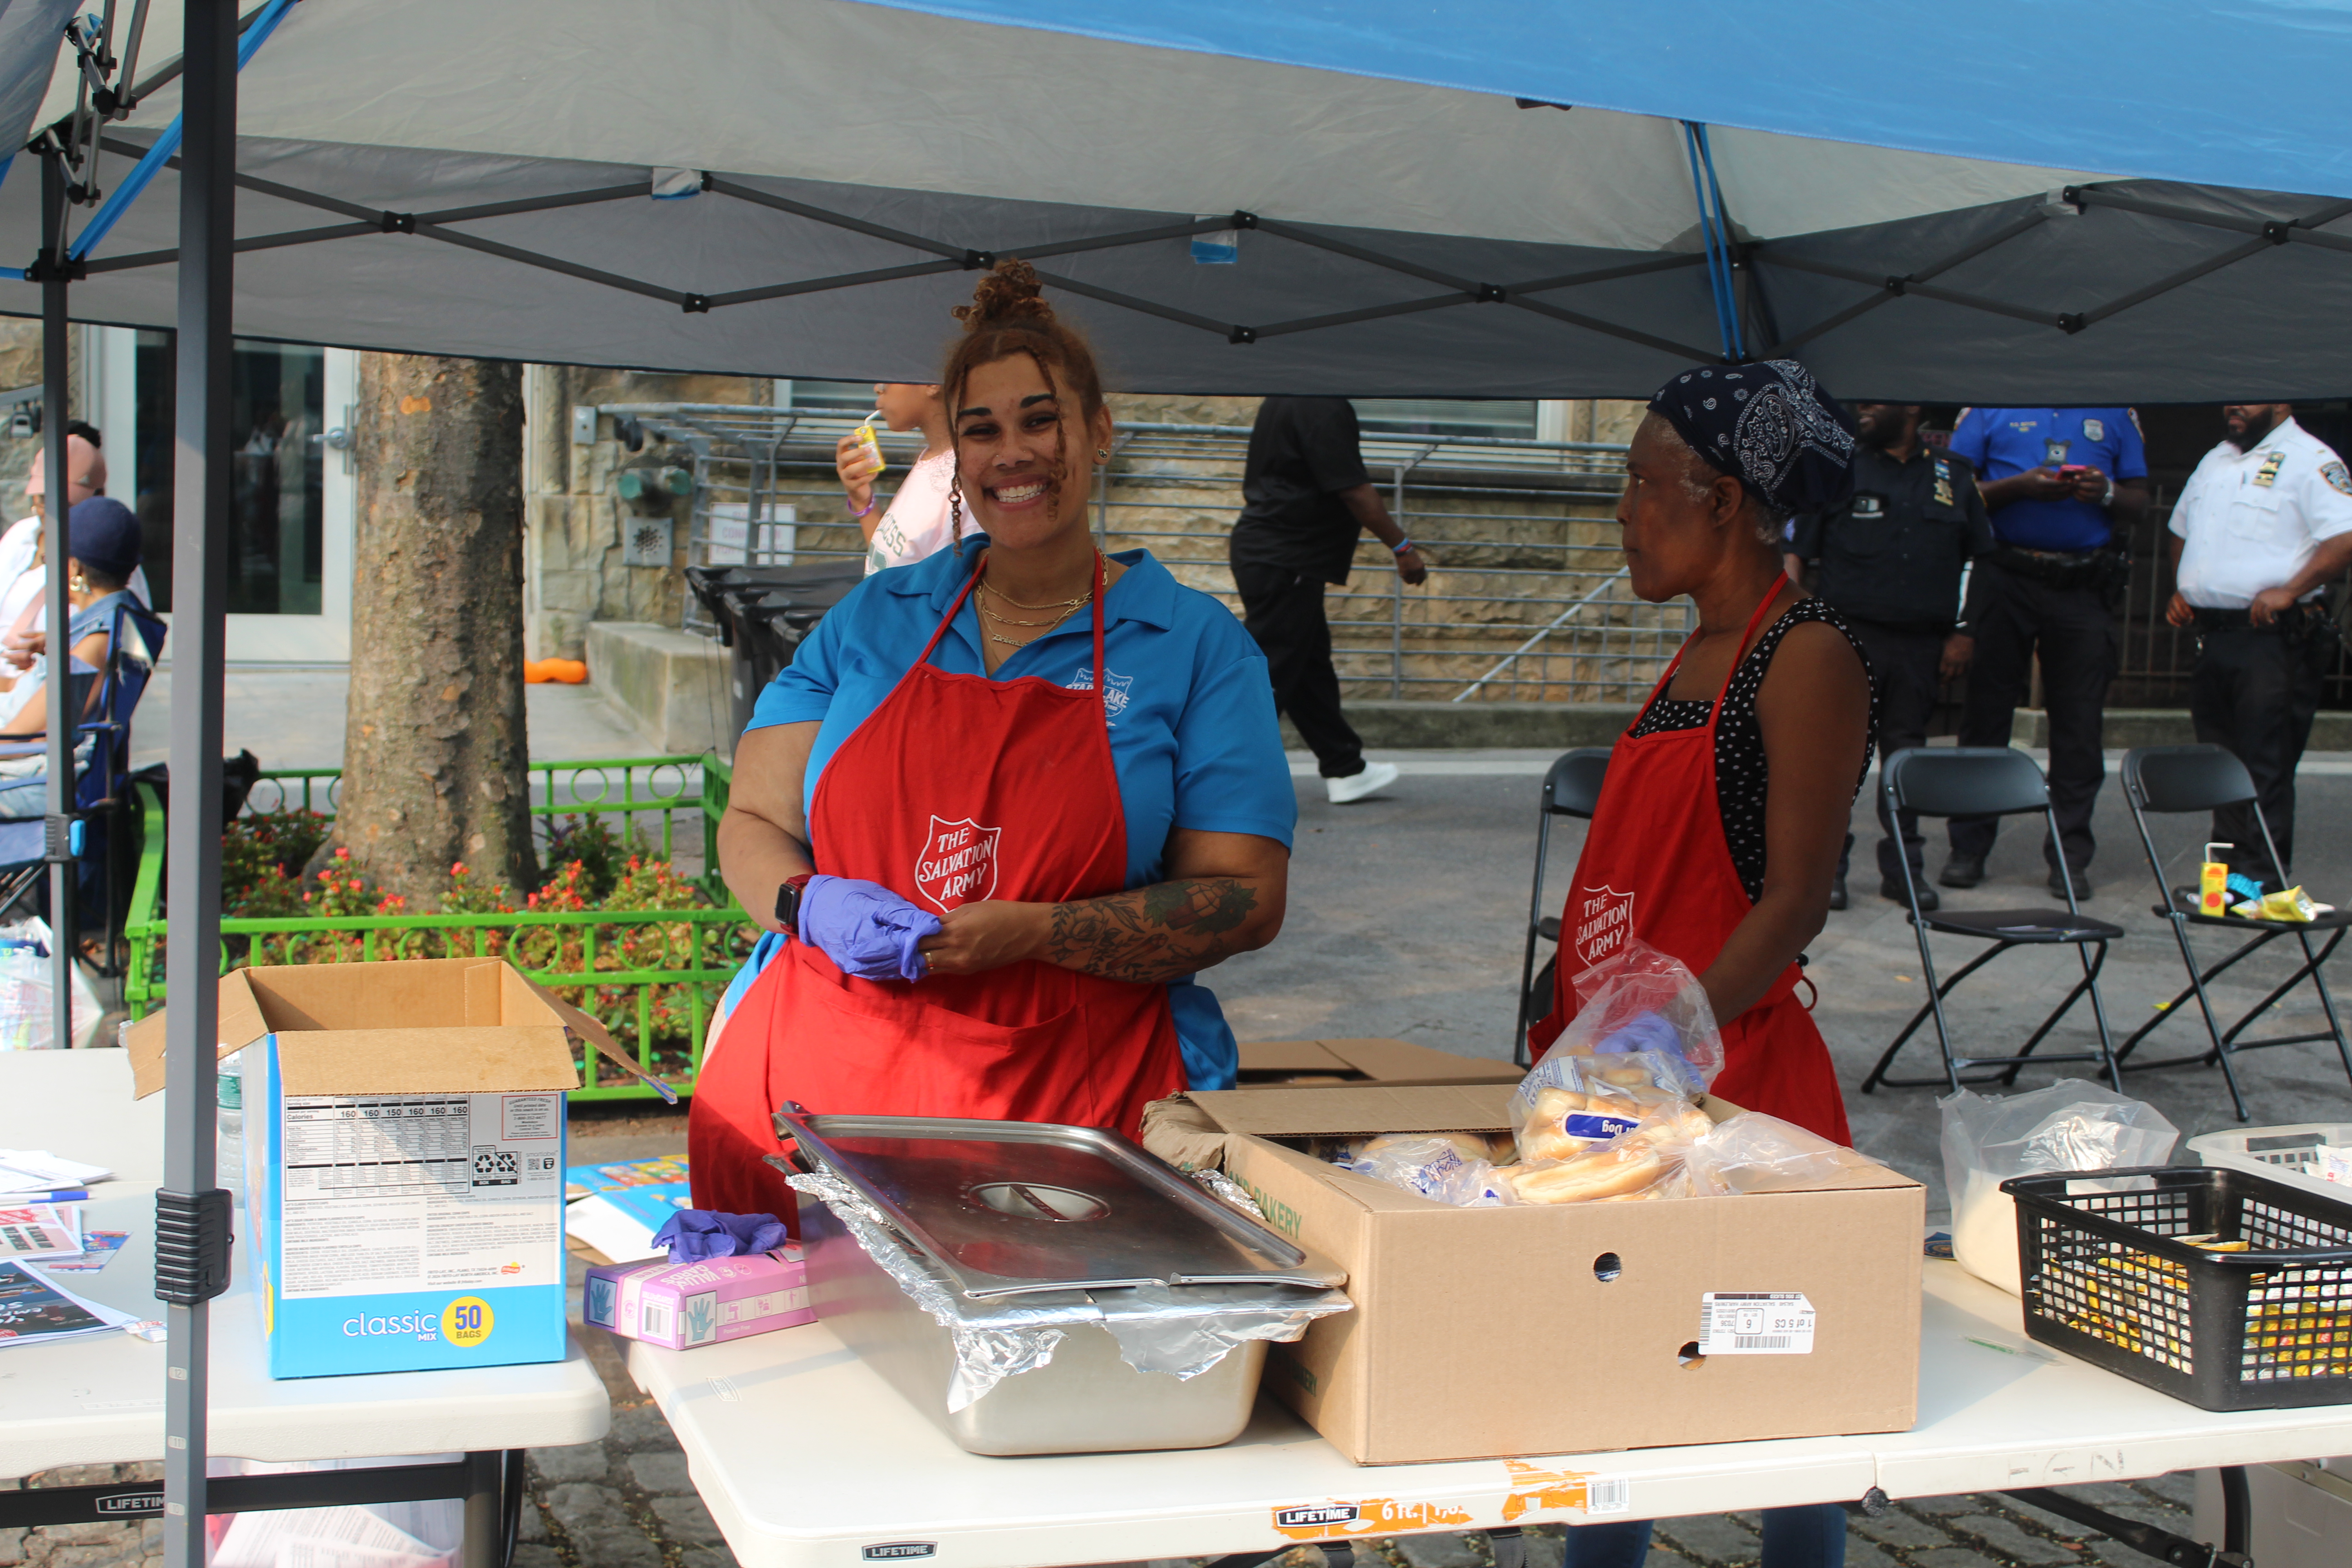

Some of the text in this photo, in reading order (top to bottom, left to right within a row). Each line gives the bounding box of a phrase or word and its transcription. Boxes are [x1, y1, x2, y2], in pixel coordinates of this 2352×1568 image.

[937, 827, 970, 853] THE
[919, 835, 993, 882] SALVATION
[939, 863, 987, 901] ARMY
[1583, 894, 1607, 917] THE
[1577, 900, 1627, 945] SALVATION
[1588, 925, 1624, 960] ARMY
[1602, 1119, 1623, 1135] Dog
[1254, 1186, 1302, 1240] BAKERY
[635, 1267, 664, 1279] Free
[343, 1309, 437, 1337] classic
[455, 1305, 482, 1330] 50
[1746, 1319, 1752, 1328] 6
[1774, 1319, 1786, 1328] CS
[1796, 1319, 1805, 1328] of
[1808, 1319, 1812, 1327] 1
[417, 1332, 438, 1341] MIX
[456, 1330, 481, 1339] BAGS
[174, 1368, 182, 1378] 12
[107, 1497, 165, 1510] LIFETIM
[1382, 1501, 1393, 1520] 6
[1286, 1508, 1350, 1523] LIFETIME
[872, 1544, 928, 1558] LIFETIME
